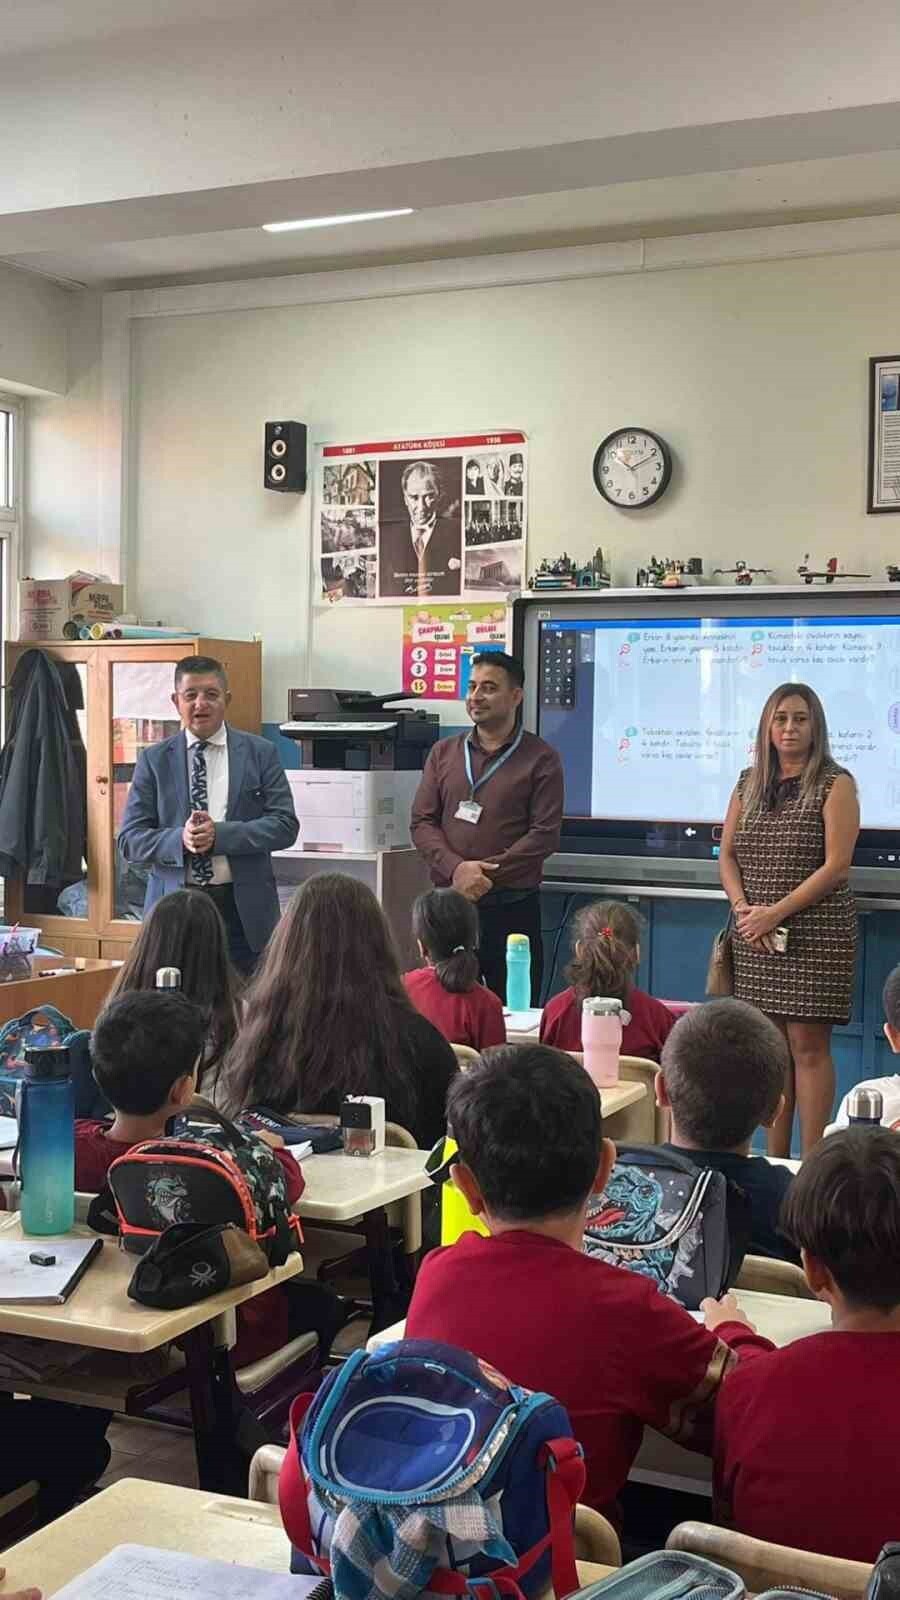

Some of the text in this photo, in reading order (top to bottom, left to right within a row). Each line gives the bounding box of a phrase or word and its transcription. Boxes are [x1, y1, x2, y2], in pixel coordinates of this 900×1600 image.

[627, 435, 637, 444] 12
[393, 440, 422, 450] ATATÜRK
[650, 448, 657, 456] 2
[602, 466, 609, 474] 9
[655, 462, 662, 471] 3
[650, 476, 657, 484] 4
[615, 488, 622, 497] 7
[628, 491, 635, 500] 6
[642, 486, 649, 496] 5
[416, 650, 423, 659] 5
[414, 682, 424, 691] 15
